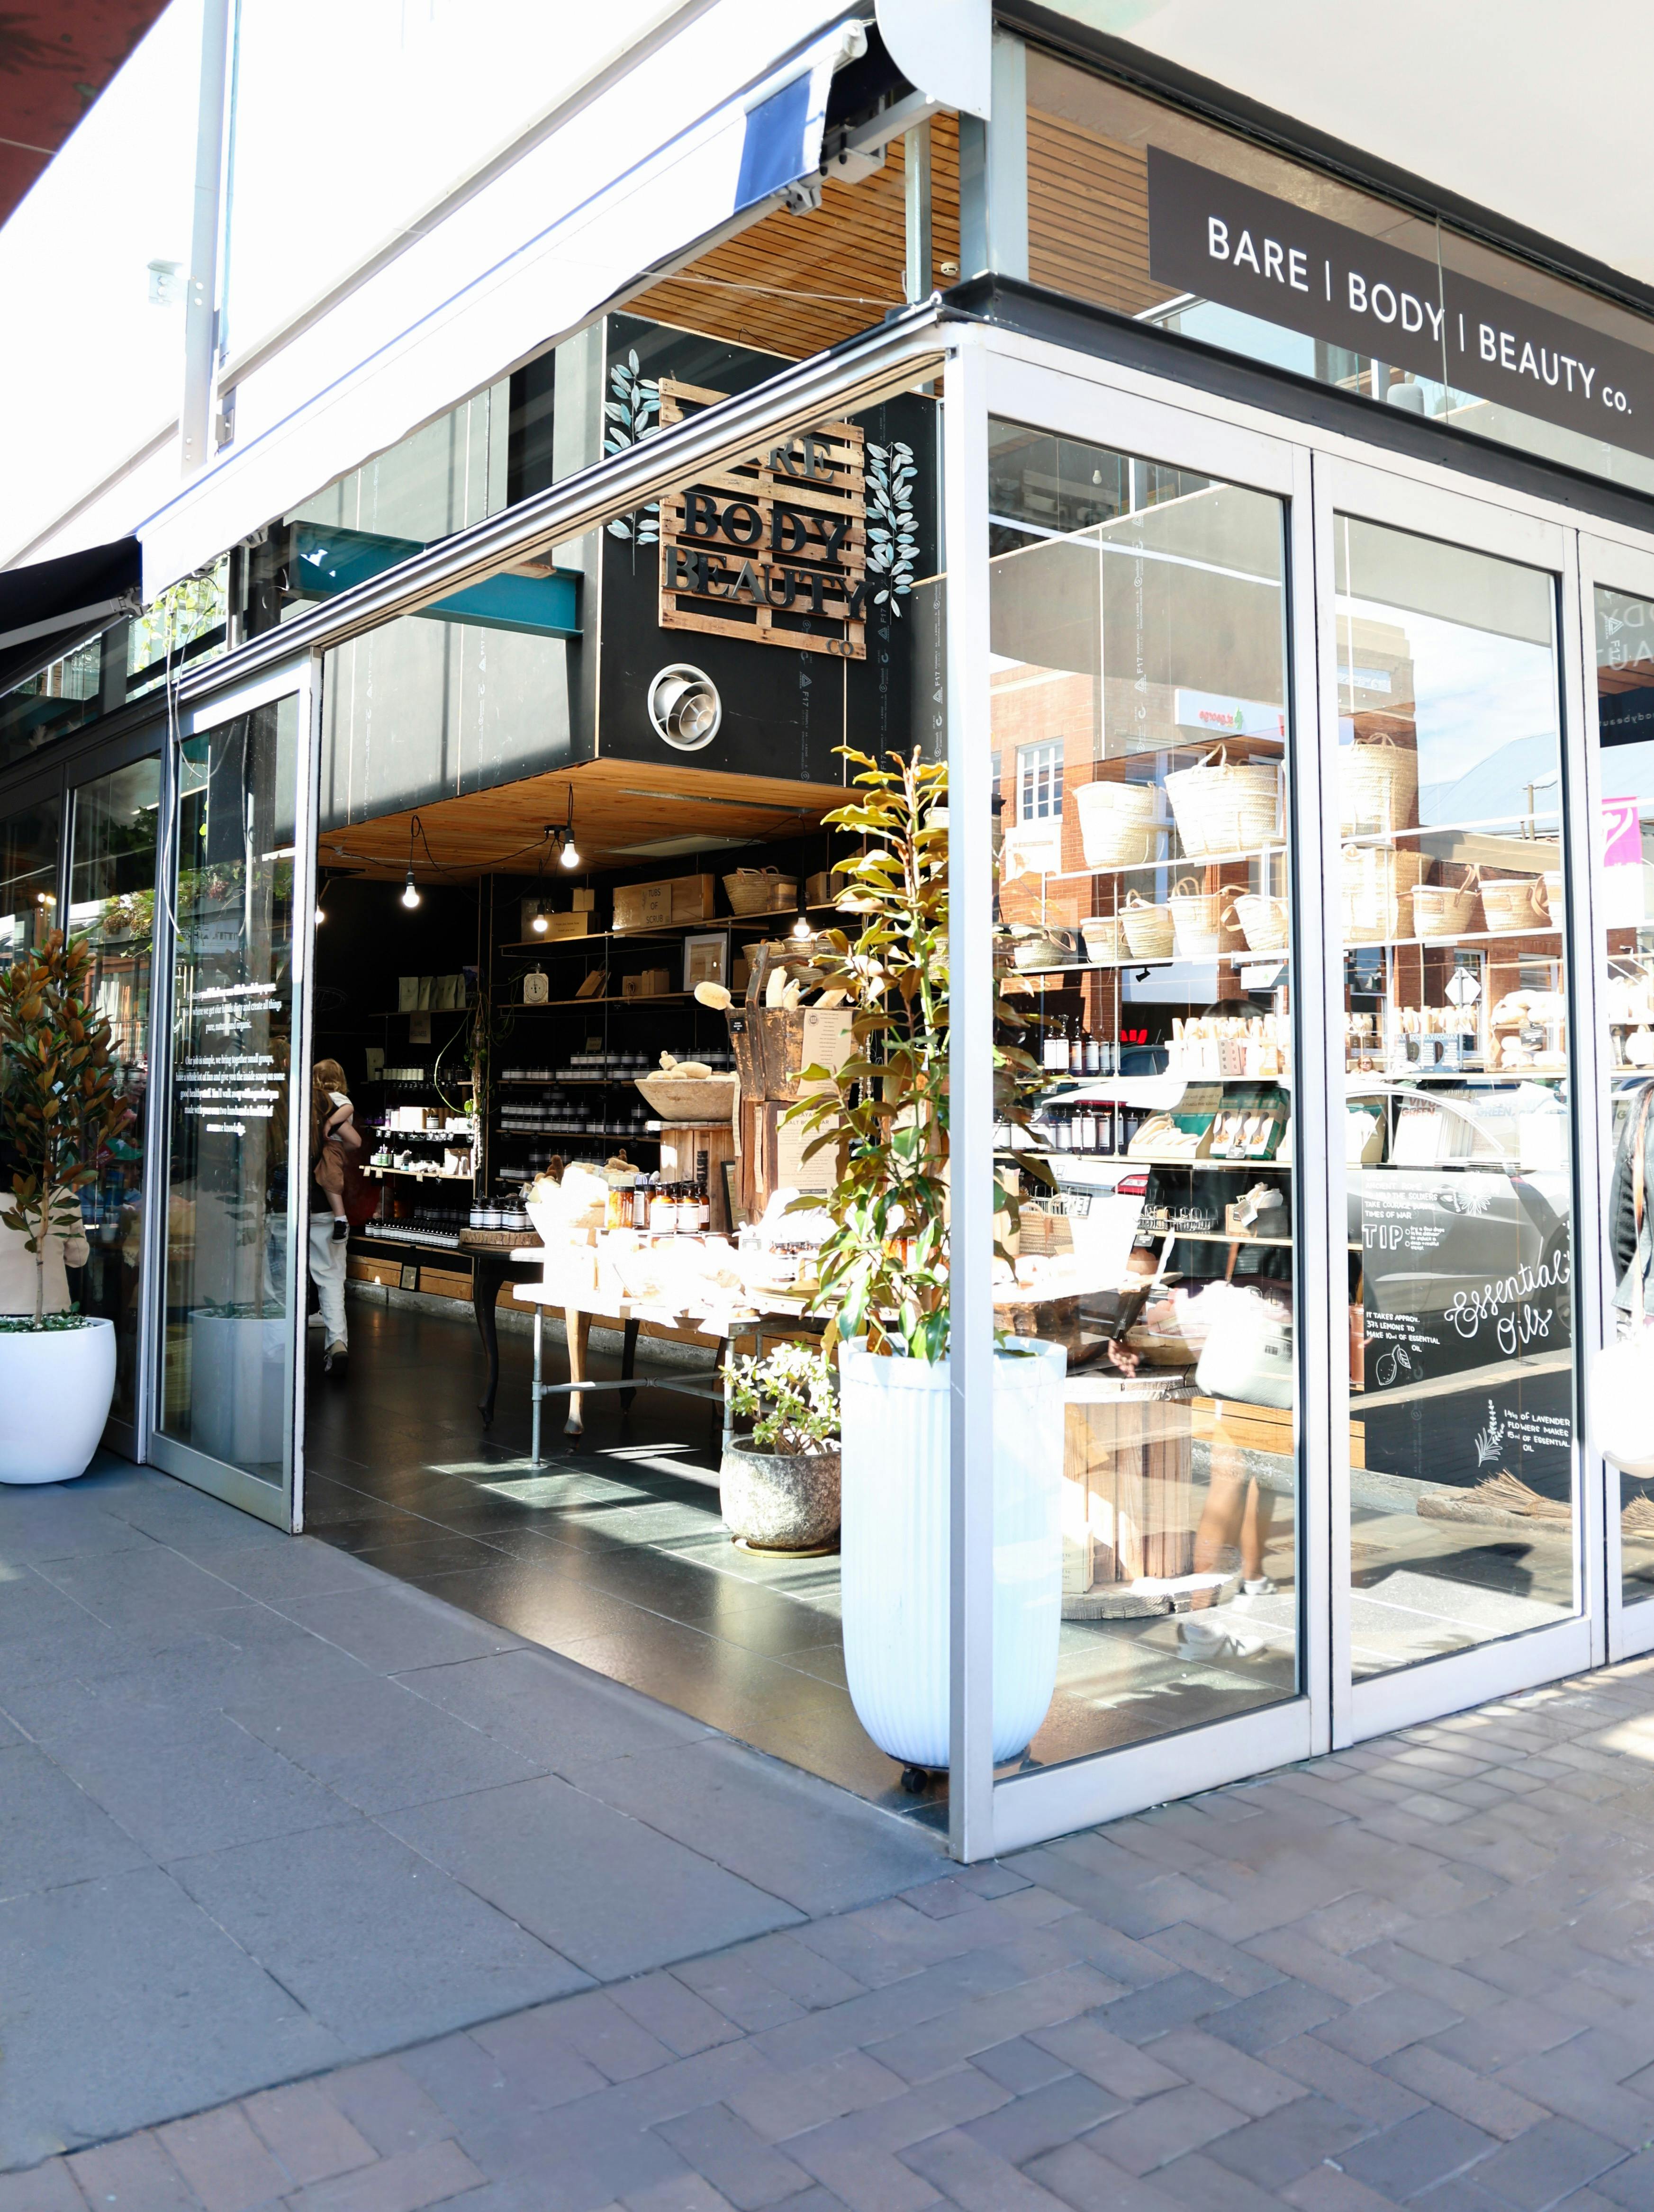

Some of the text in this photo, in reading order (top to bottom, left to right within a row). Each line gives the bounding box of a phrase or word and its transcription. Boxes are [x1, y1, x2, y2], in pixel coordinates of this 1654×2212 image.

[1209, 216, 1633, 414] BARE BODY BEAUTY co.
[680, 491, 852, 564] BODY
[664, 545, 875, 620] BEAUTY
[826, 638, 854, 656] CO
[1611, 640, 1621, 661] F17
[648, 888, 661, 897] TUBS
[651, 902, 658, 910] OF
[646, 915, 663, 924] SCRUB
[187, 991, 201, 1001] Ustairs
[232, 1053, 247, 1066] together
[1409, 1193, 1438, 1201] SOLDIERS
[1383, 1201, 1410, 1210] COURAGE
[1445, 1250, 1571, 1338] Essential
[1373, 1313, 1393, 1321] TAKES
[1395, 1314, 1420, 1323] APPROX.
[1380, 1322, 1405, 1331] LEMONS
[1497, 1304, 1553, 1354] Oils
[1366, 1330, 1383, 1339] MAKE
[1409, 1335, 1440, 1345] ESSENTIAL
[1532, 1414, 1571, 1427] LAVENDER
[1507, 1421, 1569, 1437] FLOWERS MAKES
[1507, 1431, 1520, 1440] 15ml
[1533, 1435, 1571, 1448] ESSENTIAL
[1523, 1444, 1535, 1452] OIL
